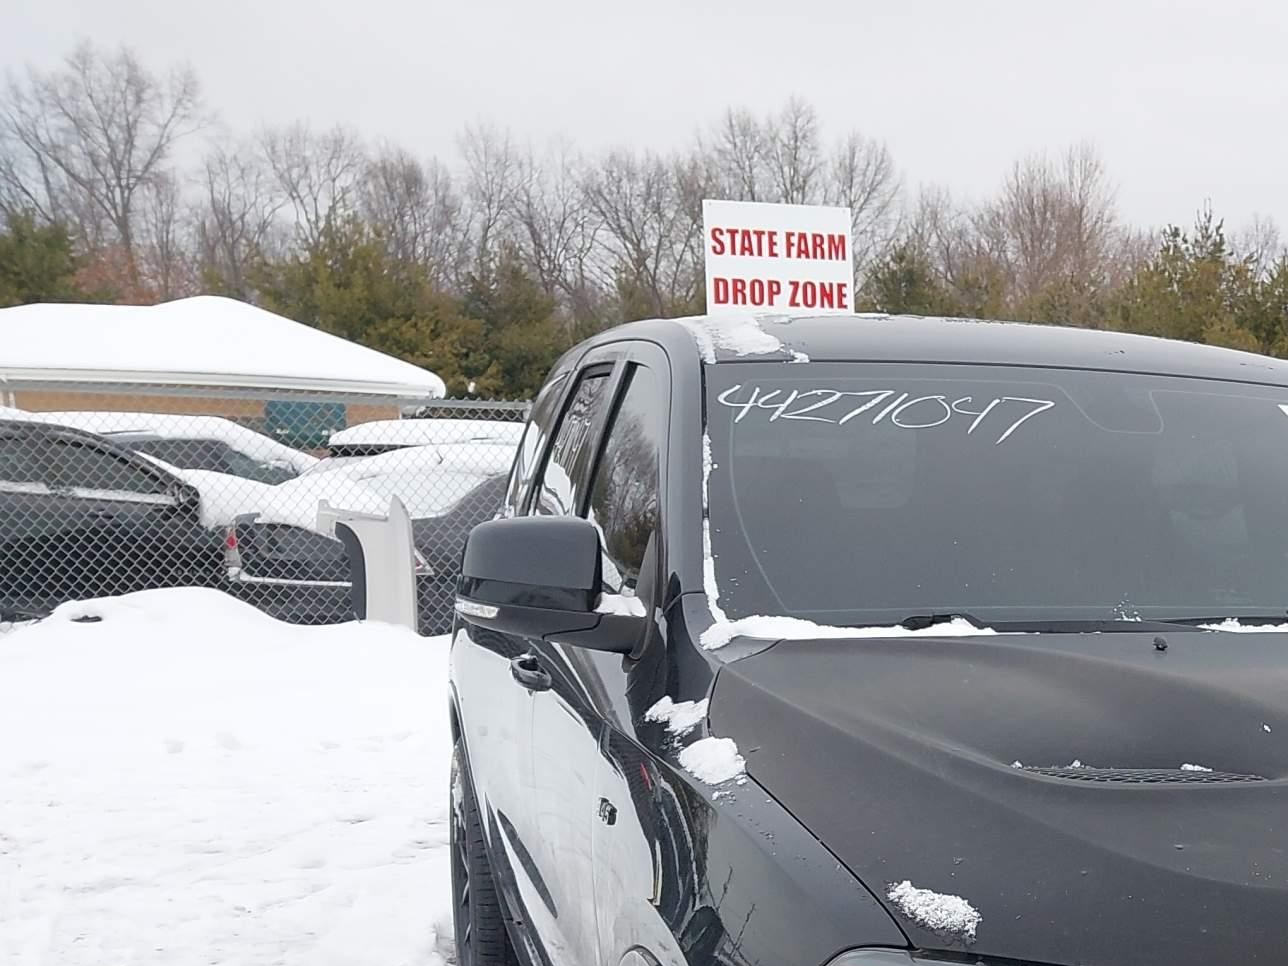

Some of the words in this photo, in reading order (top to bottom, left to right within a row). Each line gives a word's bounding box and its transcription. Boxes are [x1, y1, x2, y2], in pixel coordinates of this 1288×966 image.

[711, 227, 779, 258] STATE
[785, 231, 847, 261] FARM
[713, 277, 781, 306] DROP
[788, 280, 848, 310] ZONE
[718, 384, 1055, 445] 44271047
